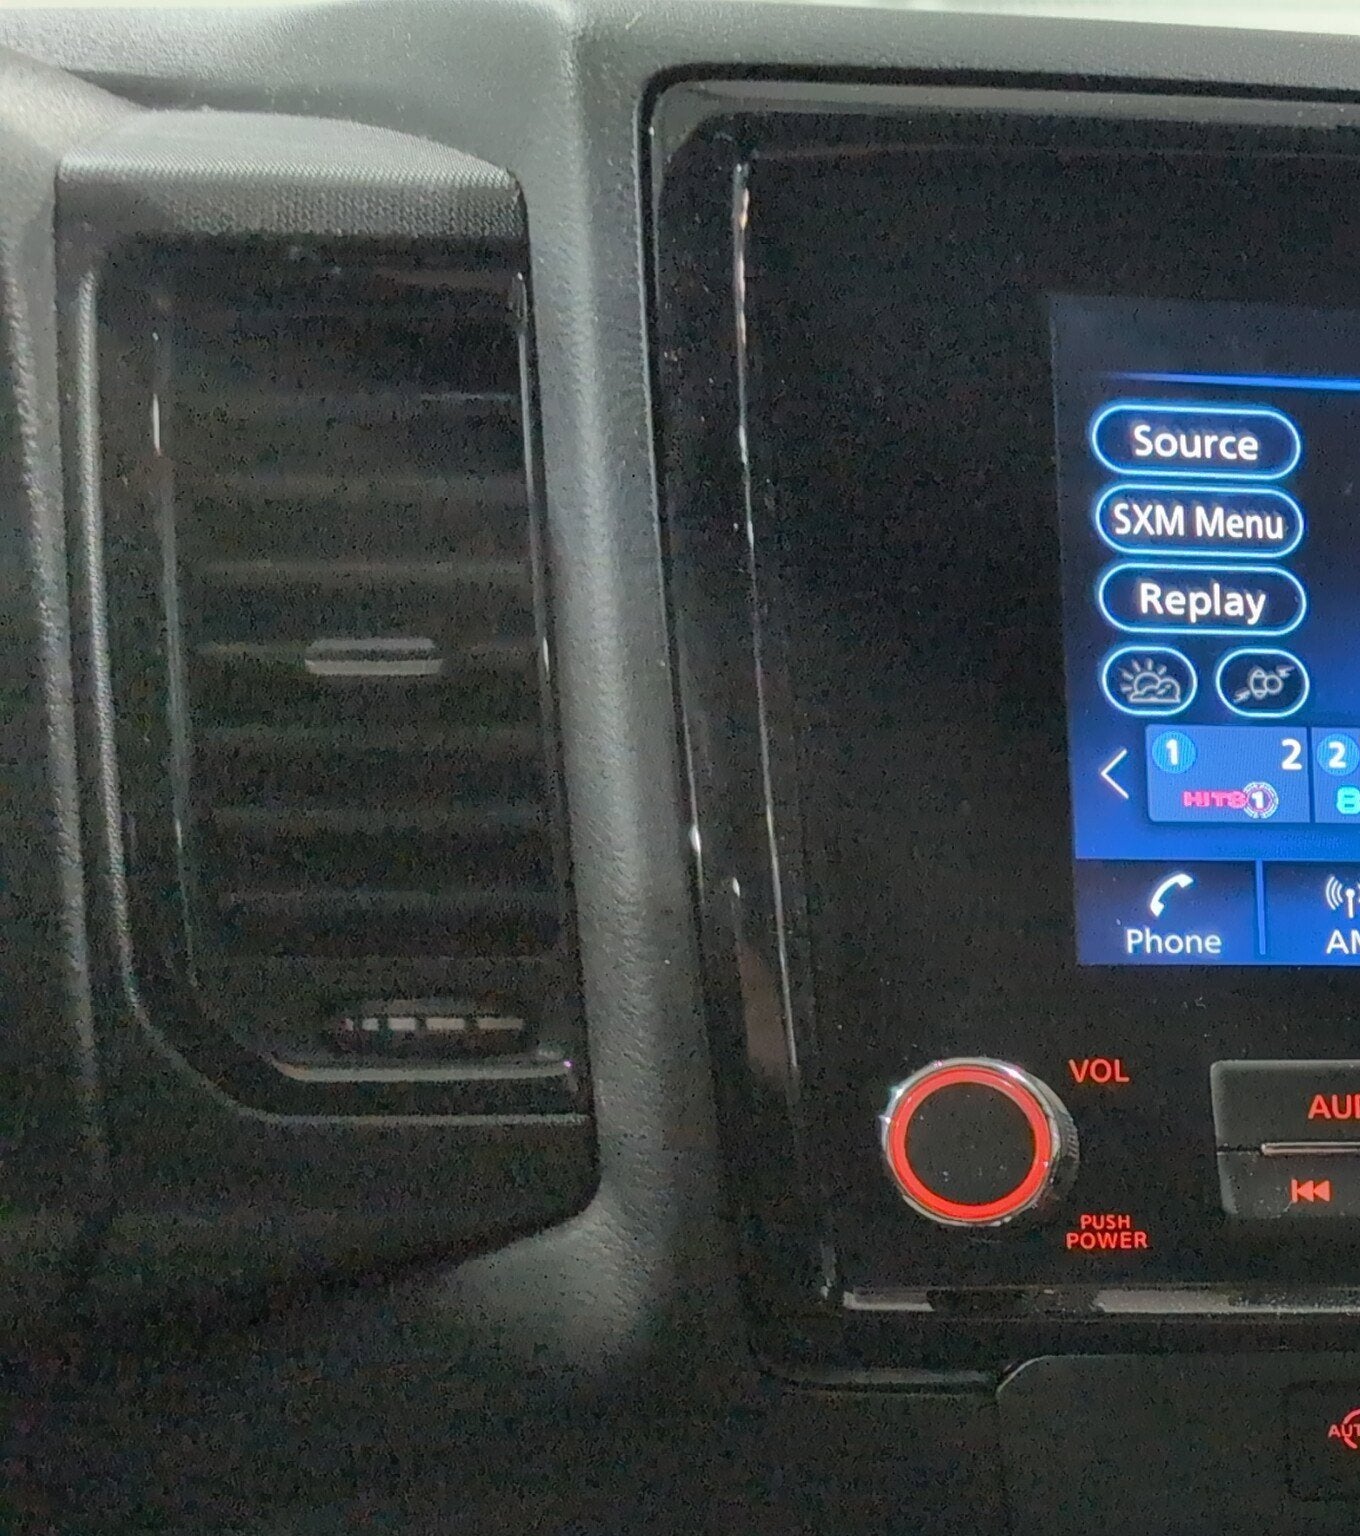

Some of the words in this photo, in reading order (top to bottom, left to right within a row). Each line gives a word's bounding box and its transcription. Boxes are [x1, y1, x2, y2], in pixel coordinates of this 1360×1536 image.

[1133, 425, 1260, 461] Source
[1113, 502, 1185, 536] SXM
[1195, 505, 1284, 540] Menu
[1140, 582, 1267, 624] Replay
[1166, 740, 1178, 764] 1
[1281, 739, 1303, 770] 2
[1328, 743, 1347, 769] 2
[1126, 928, 1222, 955] Phone
[1068, 1058, 1130, 1083] VOL
[1080, 1214, 1131, 1231] PUSH
[1065, 1231, 1149, 1250] POWER
